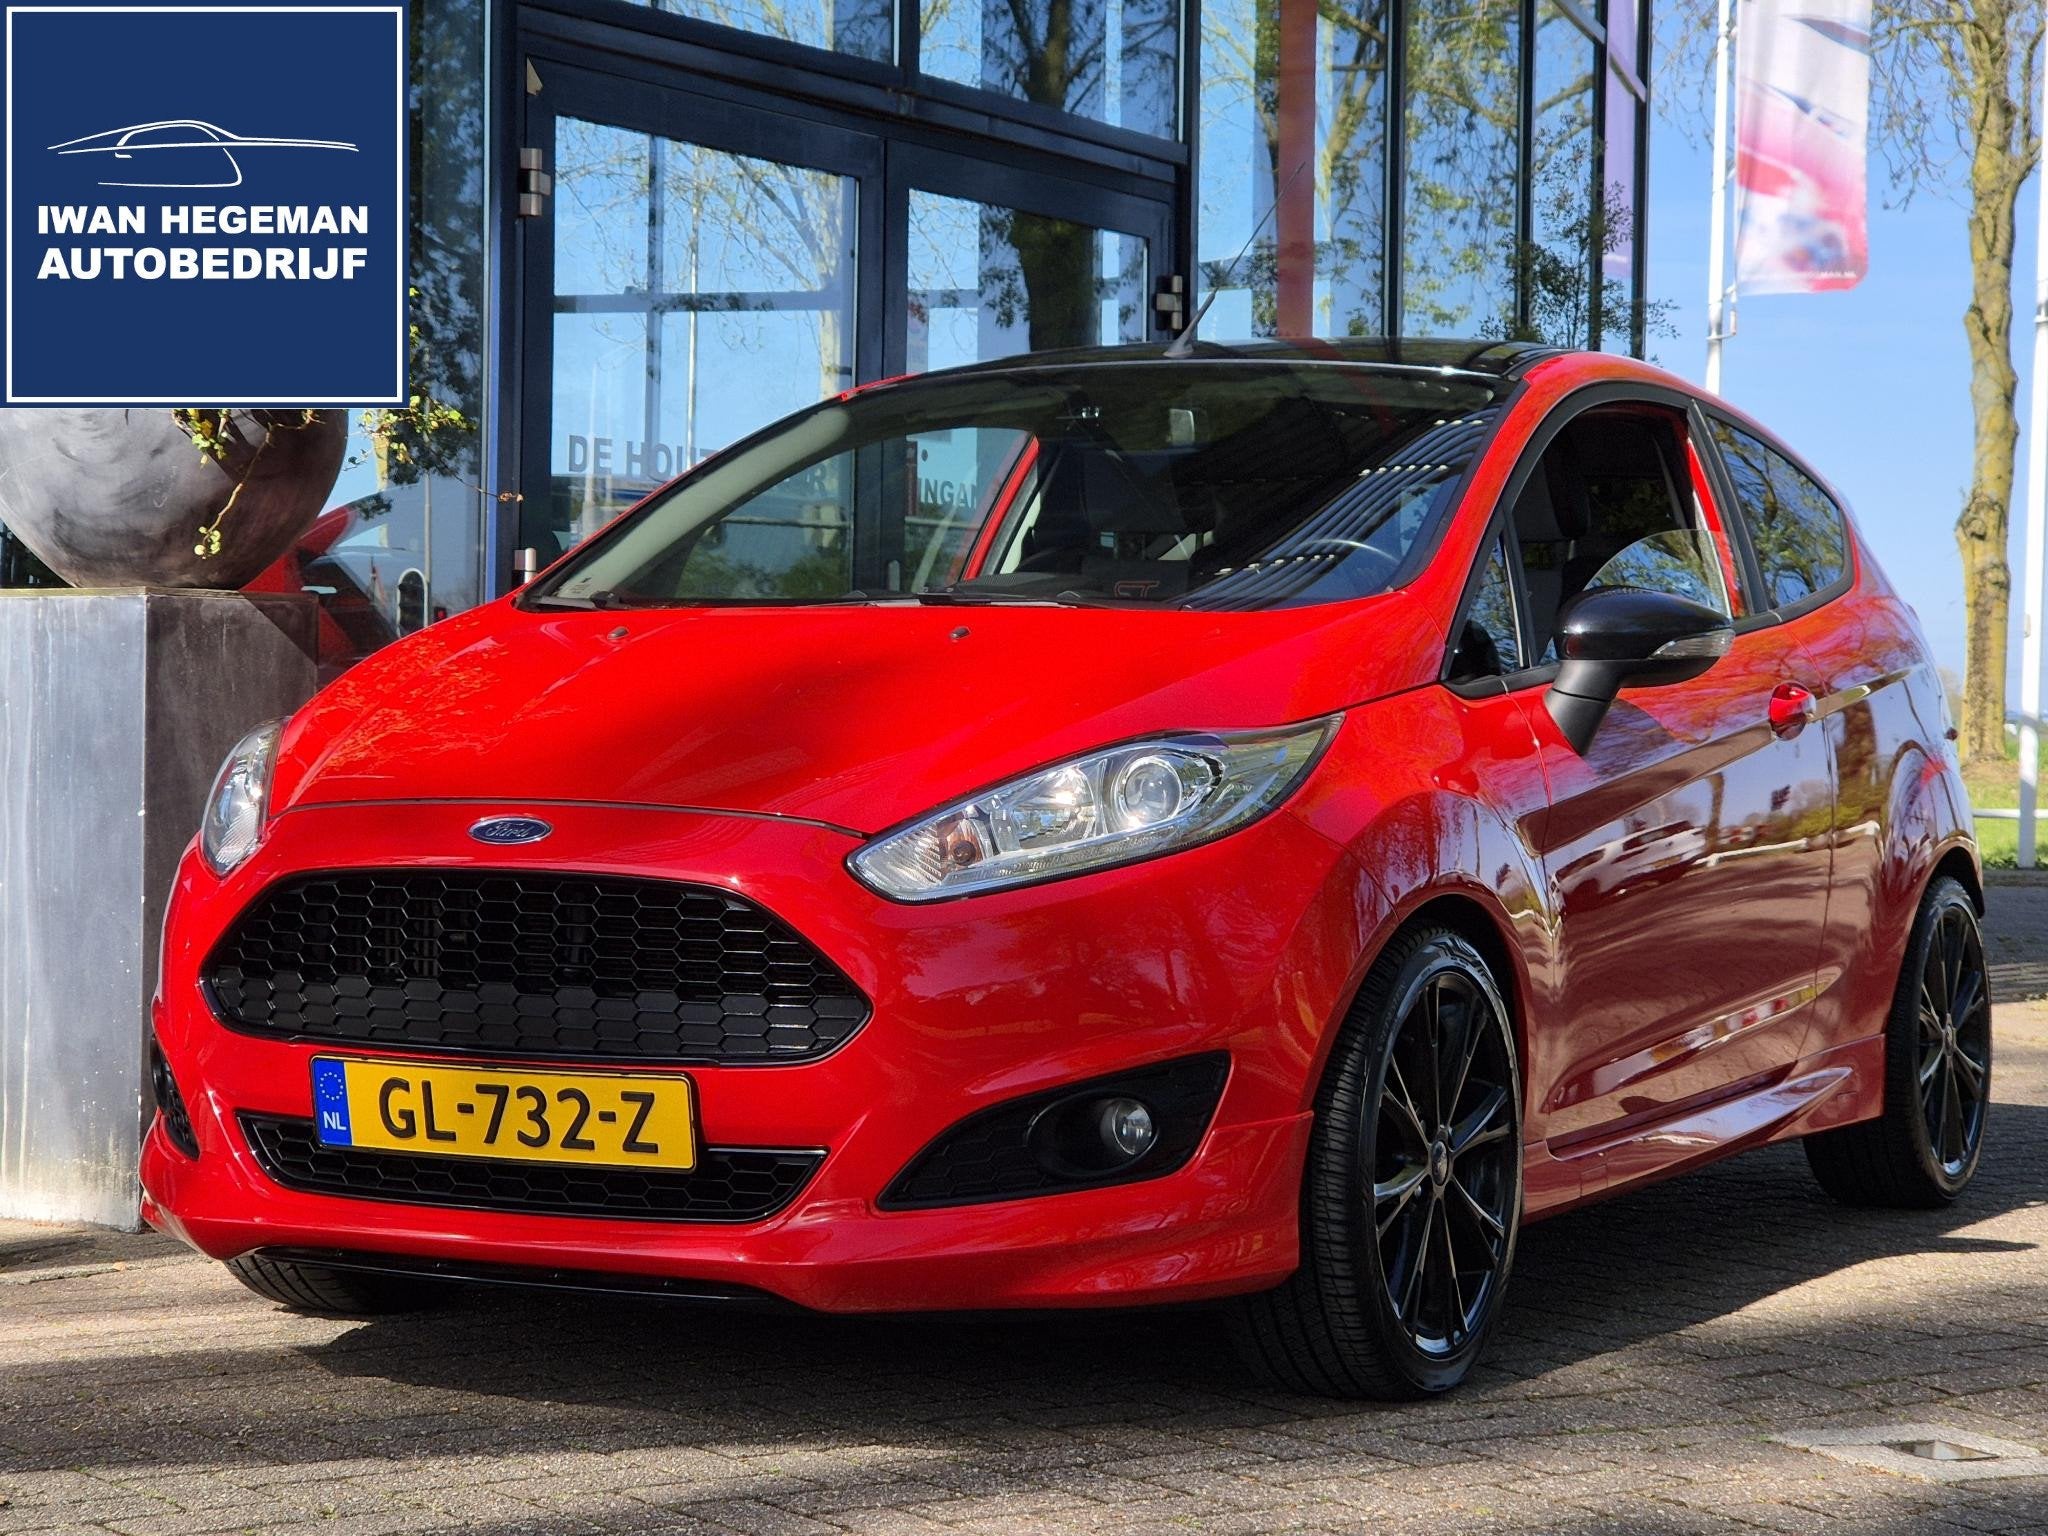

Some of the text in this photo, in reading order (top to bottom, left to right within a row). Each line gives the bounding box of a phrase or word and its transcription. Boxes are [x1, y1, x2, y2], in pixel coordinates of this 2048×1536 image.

[568, 434, 613, 475] DE
[484, 821, 535, 838] Ford
[322, 1110, 348, 1132] NL
[379, 1078, 660, 1154] GL-732-Z
